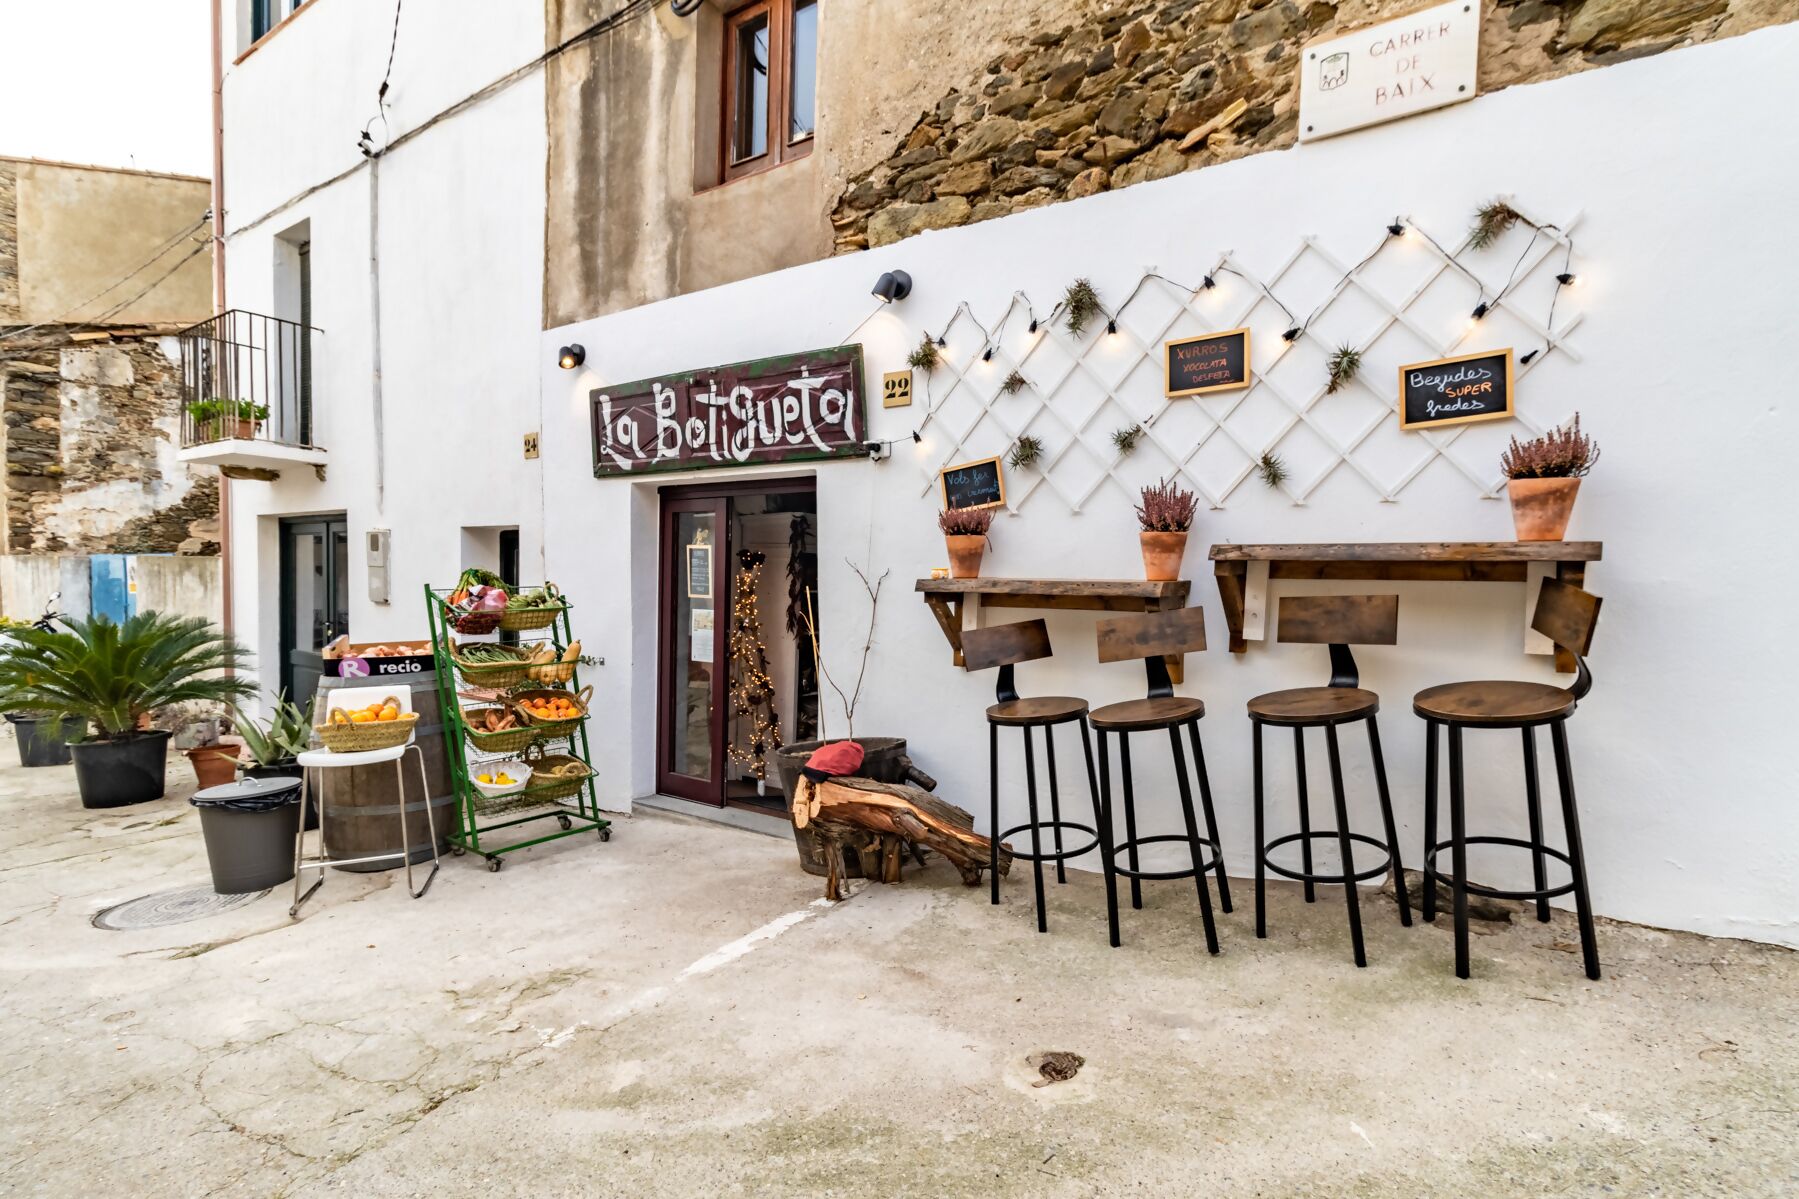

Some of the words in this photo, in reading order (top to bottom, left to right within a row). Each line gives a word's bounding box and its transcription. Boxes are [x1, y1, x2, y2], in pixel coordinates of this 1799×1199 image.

[1369, 21, 1451, 57] CARRER
[1396, 55, 1422, 74] DE
[1375, 72, 1436, 106] BAIX
[1177, 343, 1228, 360] XURROS
[884, 377, 909, 399] 22
[1445, 381, 1492, 398] SUPER
[524, 437, 537, 453] 24
[342, 660, 368, 677] R
[379, 660, 422, 674] recio
